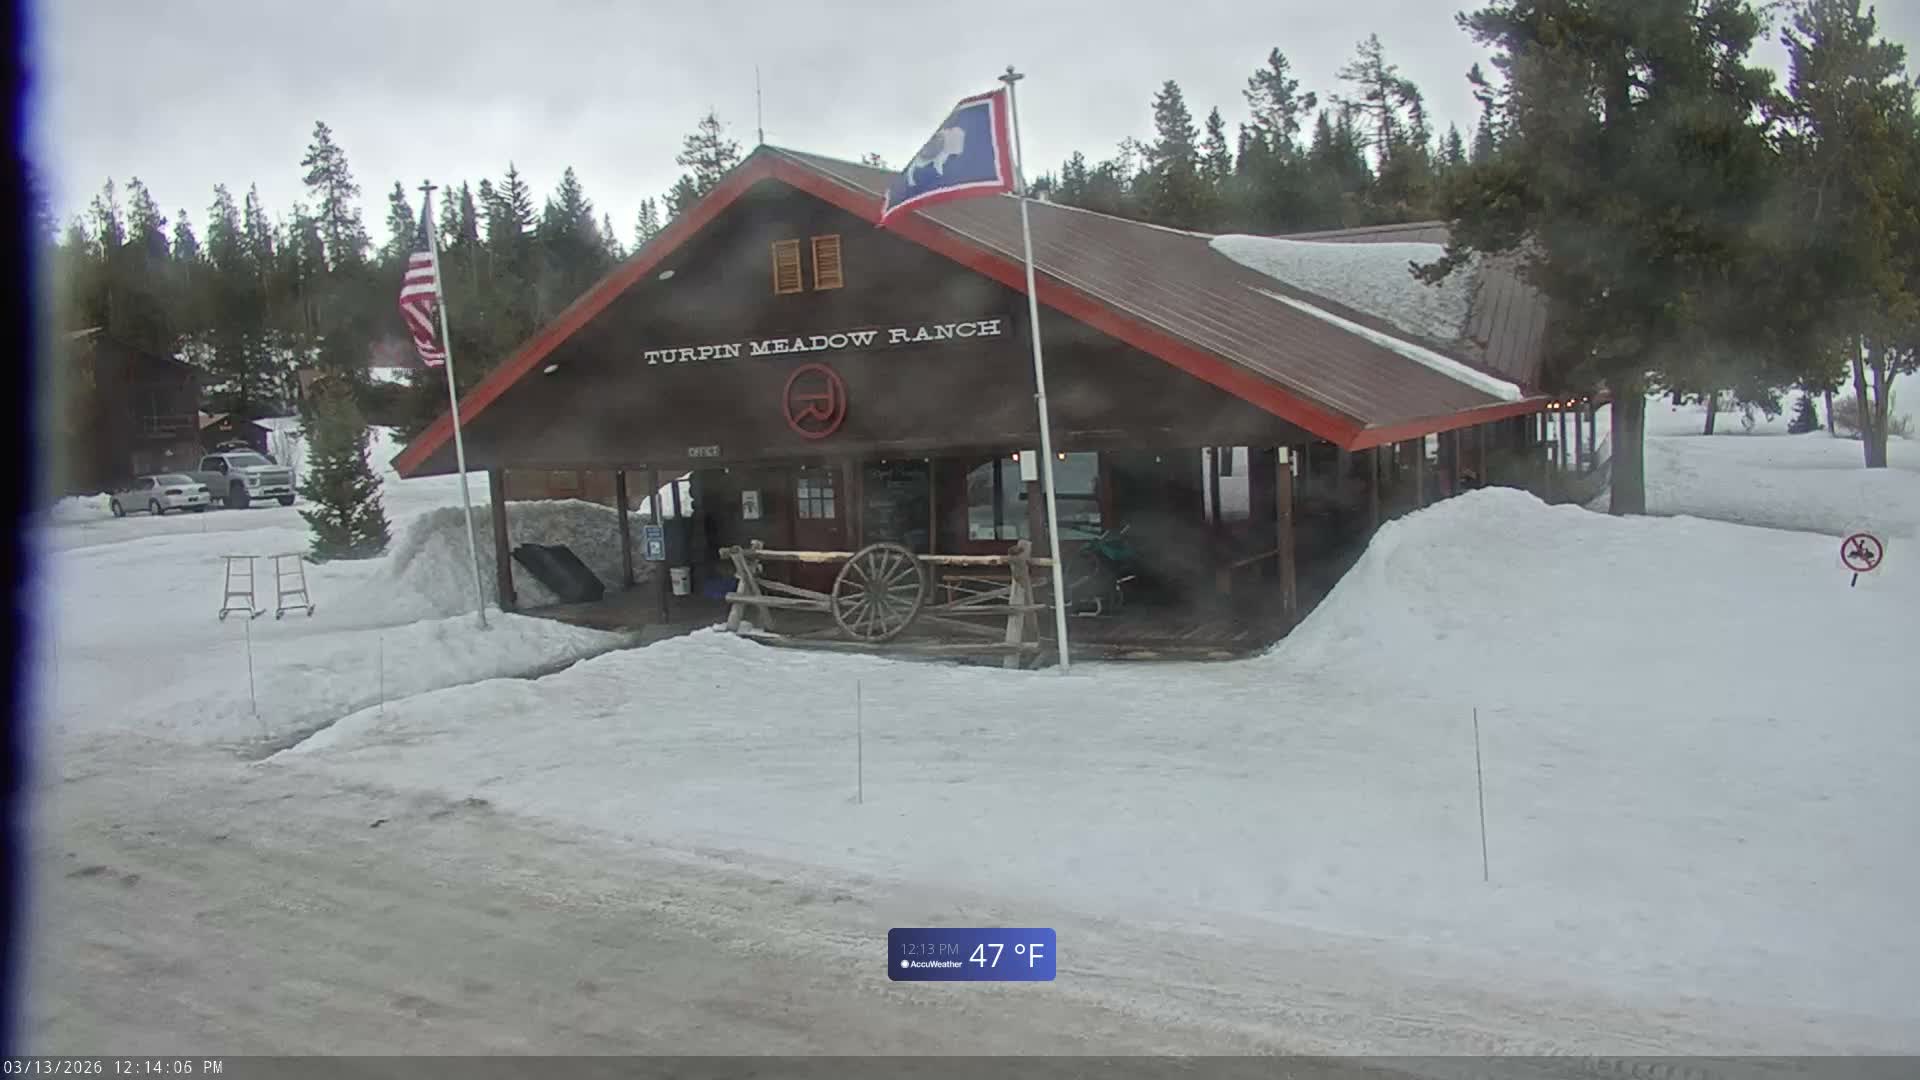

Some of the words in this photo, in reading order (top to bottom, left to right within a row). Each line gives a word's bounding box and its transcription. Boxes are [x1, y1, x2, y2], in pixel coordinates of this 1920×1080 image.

[644, 343, 741, 365] TURPIN
[750, 330, 877, 356] MEADOW
[888, 319, 1001, 345] RANCH
